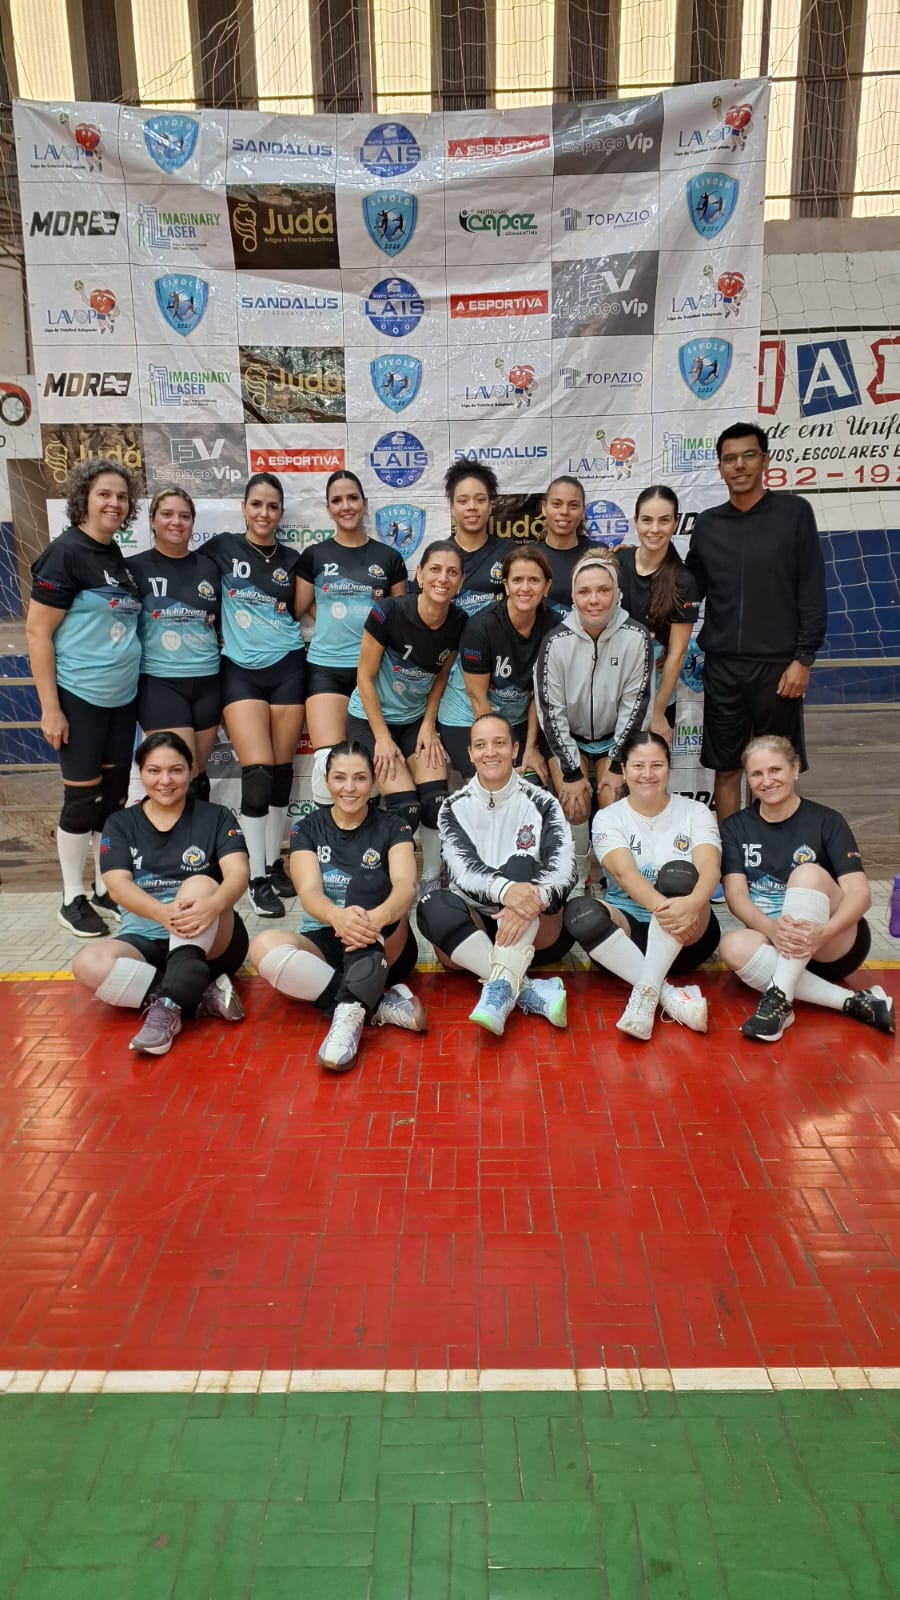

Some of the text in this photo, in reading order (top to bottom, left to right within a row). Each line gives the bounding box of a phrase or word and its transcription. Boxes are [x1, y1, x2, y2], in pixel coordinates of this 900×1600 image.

[232, 139, 333, 157] SANDALUS
[360, 146, 422, 163] LAIS
[158, 212, 221, 226] IMAGINARY
[262, 205, 335, 235] Judá
[586, 209, 650, 227] TOPAZIO
[160, 226, 197, 239] LASER
[241, 297, 340, 310] SANDALUS
[364, 300, 426, 316] LAIS
[456, 296, 544, 312] A ESPORTIVA
[169, 371, 233, 384] IMAGINARY
[586, 371, 644, 385] TOPAZIO
[170, 383, 206, 396] LASER
[798, 422, 834, 439] em
[683, 438, 719, 449] IMAGI
[256, 455, 340, 466] A ESPORTIVA
[370, 452, 429, 467] LAIS
[454, 446, 548, 461] SANDALUS
[588, 519, 630, 535] AIS
[232, 558, 252, 579] 10
[323, 562, 340, 577] 12
[148, 577, 169, 597] 17
[402, 644, 413, 660] 7
[495, 655, 513, 679] 16
[317, 845, 332, 864] 18
[742, 844, 763, 868] 15
